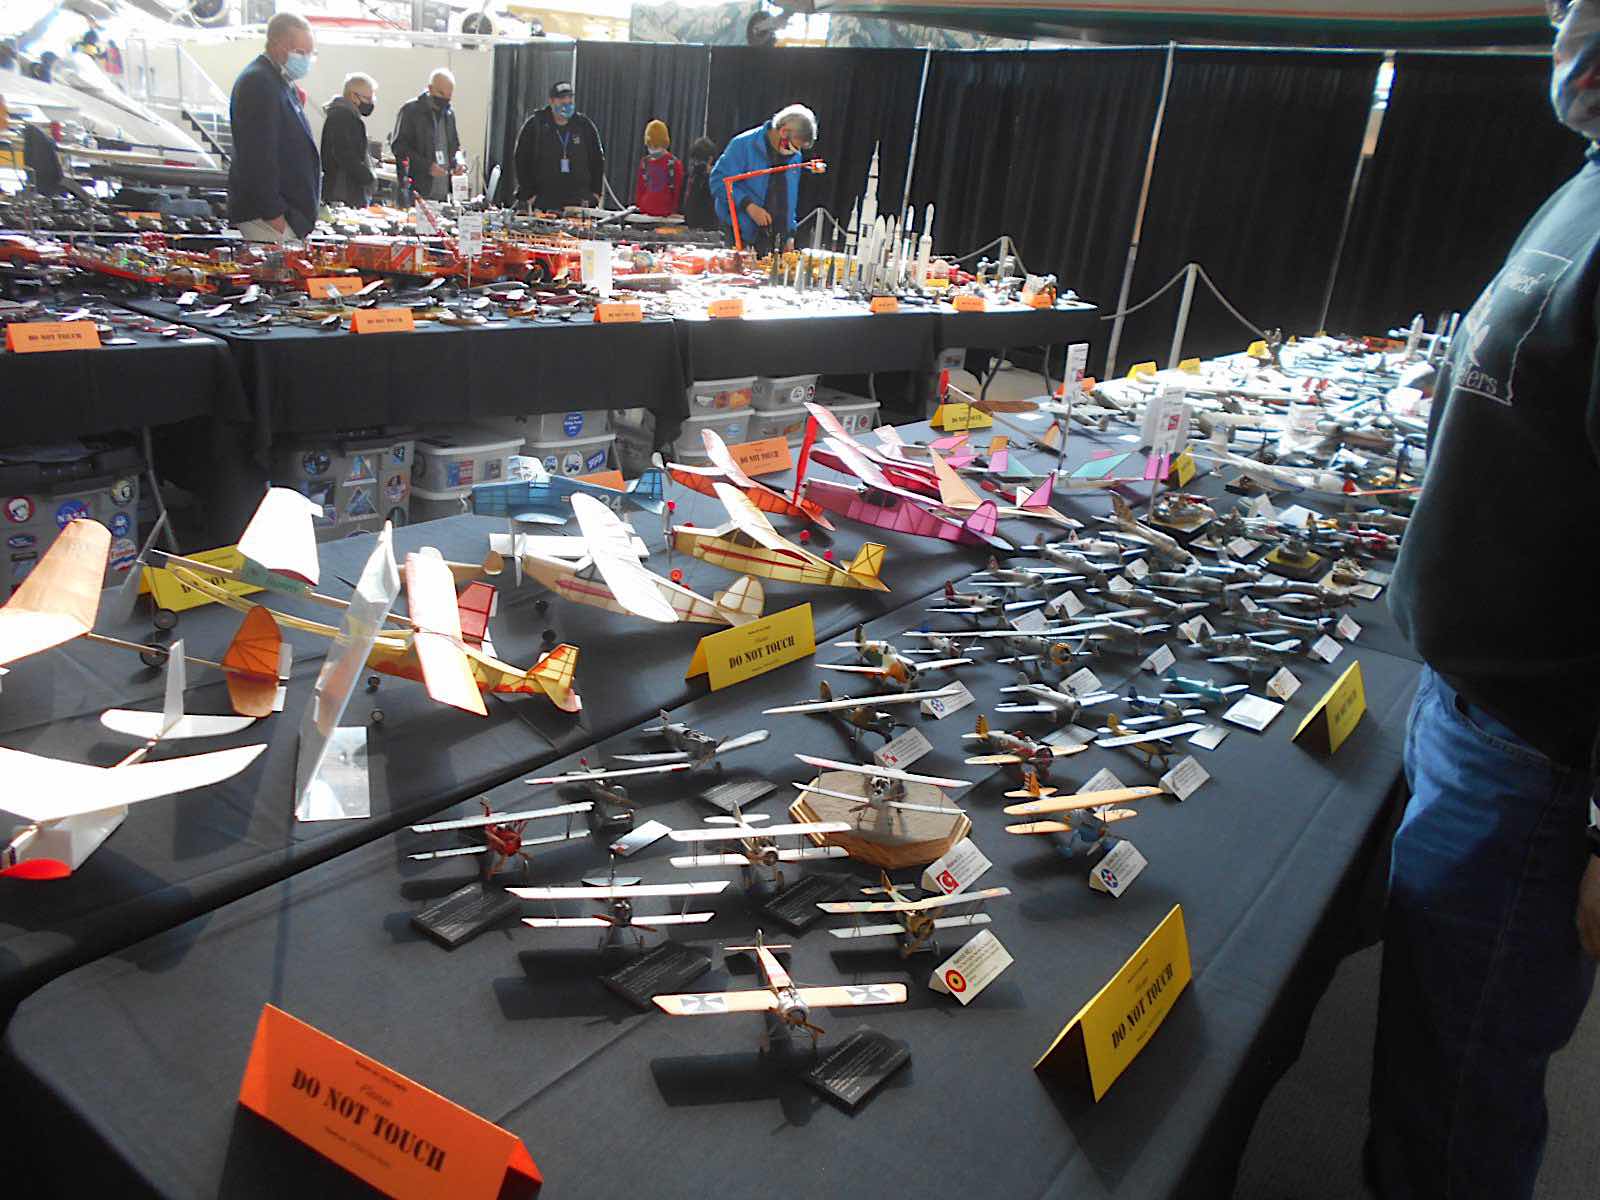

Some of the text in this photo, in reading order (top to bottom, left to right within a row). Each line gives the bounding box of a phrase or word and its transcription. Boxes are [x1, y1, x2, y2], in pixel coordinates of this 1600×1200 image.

[748, 454, 760, 462] NOT
[729, 656, 743, 668] DO
[745, 647, 763, 662] NOT
[766, 635, 794, 655] TOUCH
[1111, 1022, 1126, 1049] DO
[1126, 998, 1146, 1031] NOT
[1147, 963, 1173, 1005] TOUCH
[292, 1068, 321, 1098] DO
[323, 1087, 369, 1125] NOT
[373, 1113, 447, 1173] TOUCH
